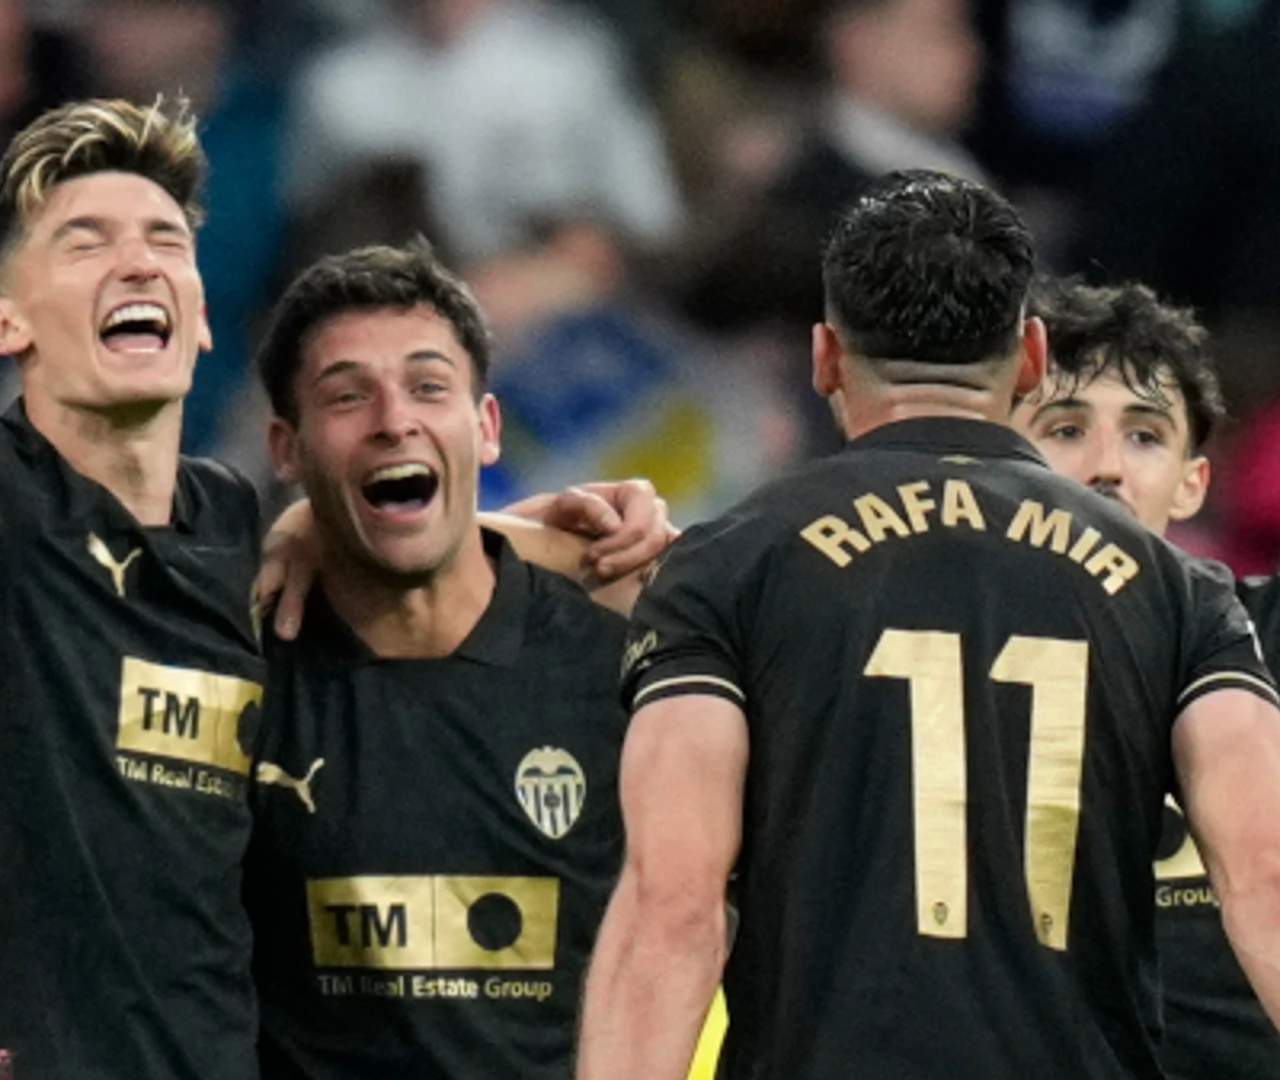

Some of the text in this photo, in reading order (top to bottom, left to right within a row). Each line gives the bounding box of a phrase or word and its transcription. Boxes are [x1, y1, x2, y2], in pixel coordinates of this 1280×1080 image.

[799, 478, 1141, 597] RAFA MIR
[136, 685, 201, 741] TM
[116, 756, 148, 782] TM
[150, 762, 194, 790] Real
[864, 627, 1090, 952] 11
[1154, 884, 1220, 907] Grou
[323, 902, 408, 949] TM
[317, 974, 553, 1002] TM Real Estate Group
